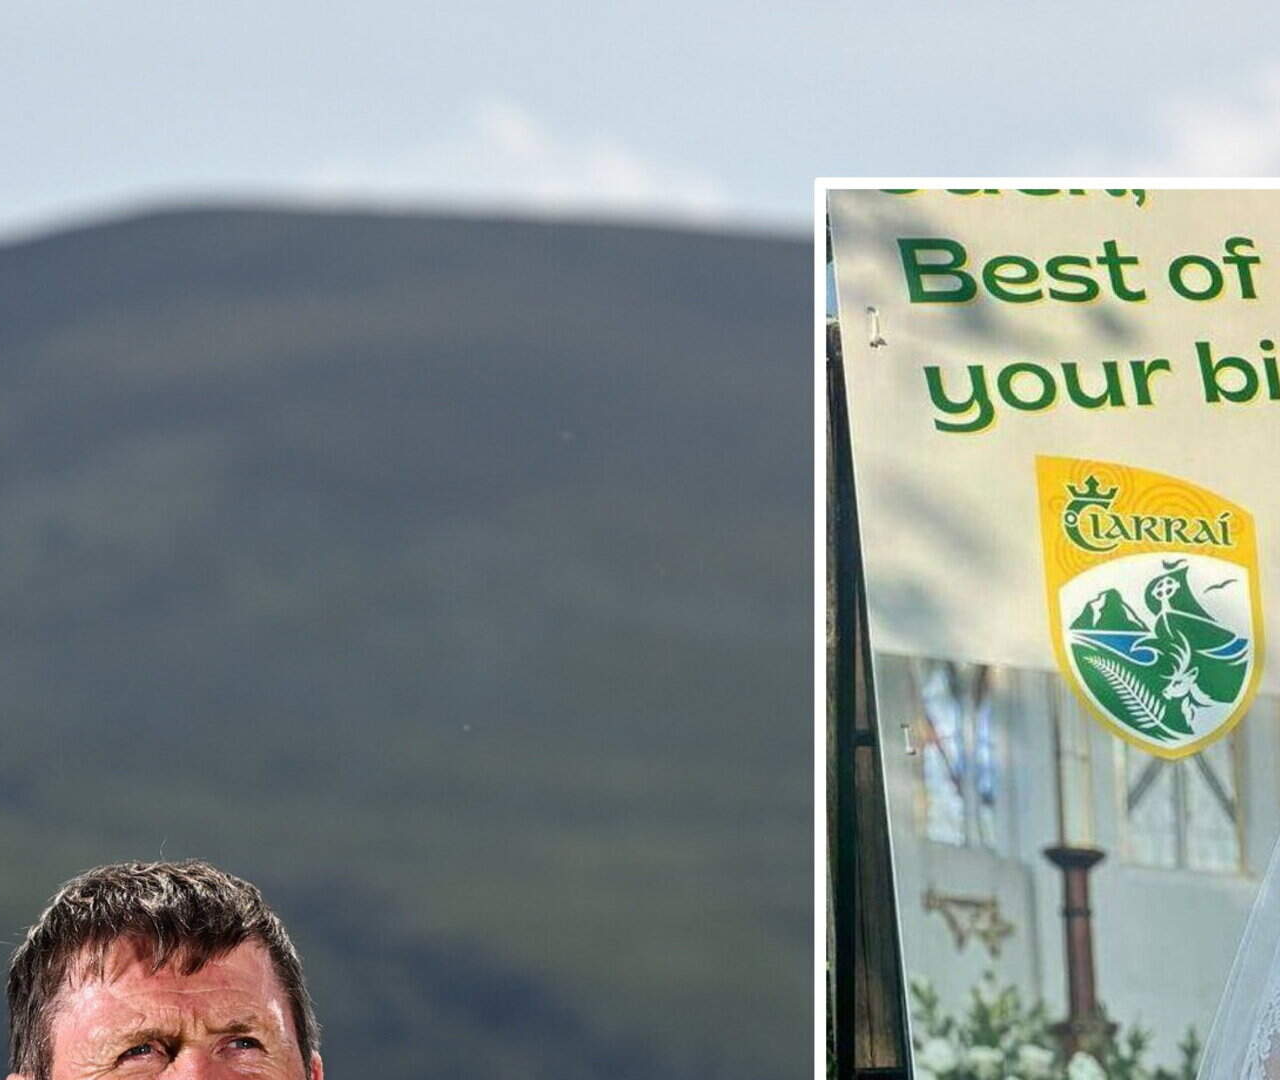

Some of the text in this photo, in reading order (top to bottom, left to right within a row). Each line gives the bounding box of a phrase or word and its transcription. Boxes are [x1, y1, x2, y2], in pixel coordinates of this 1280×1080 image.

[894, 237, 1148, 304] Best
[1167, 236, 1261, 301] of
[923, 358, 1172, 434] your
